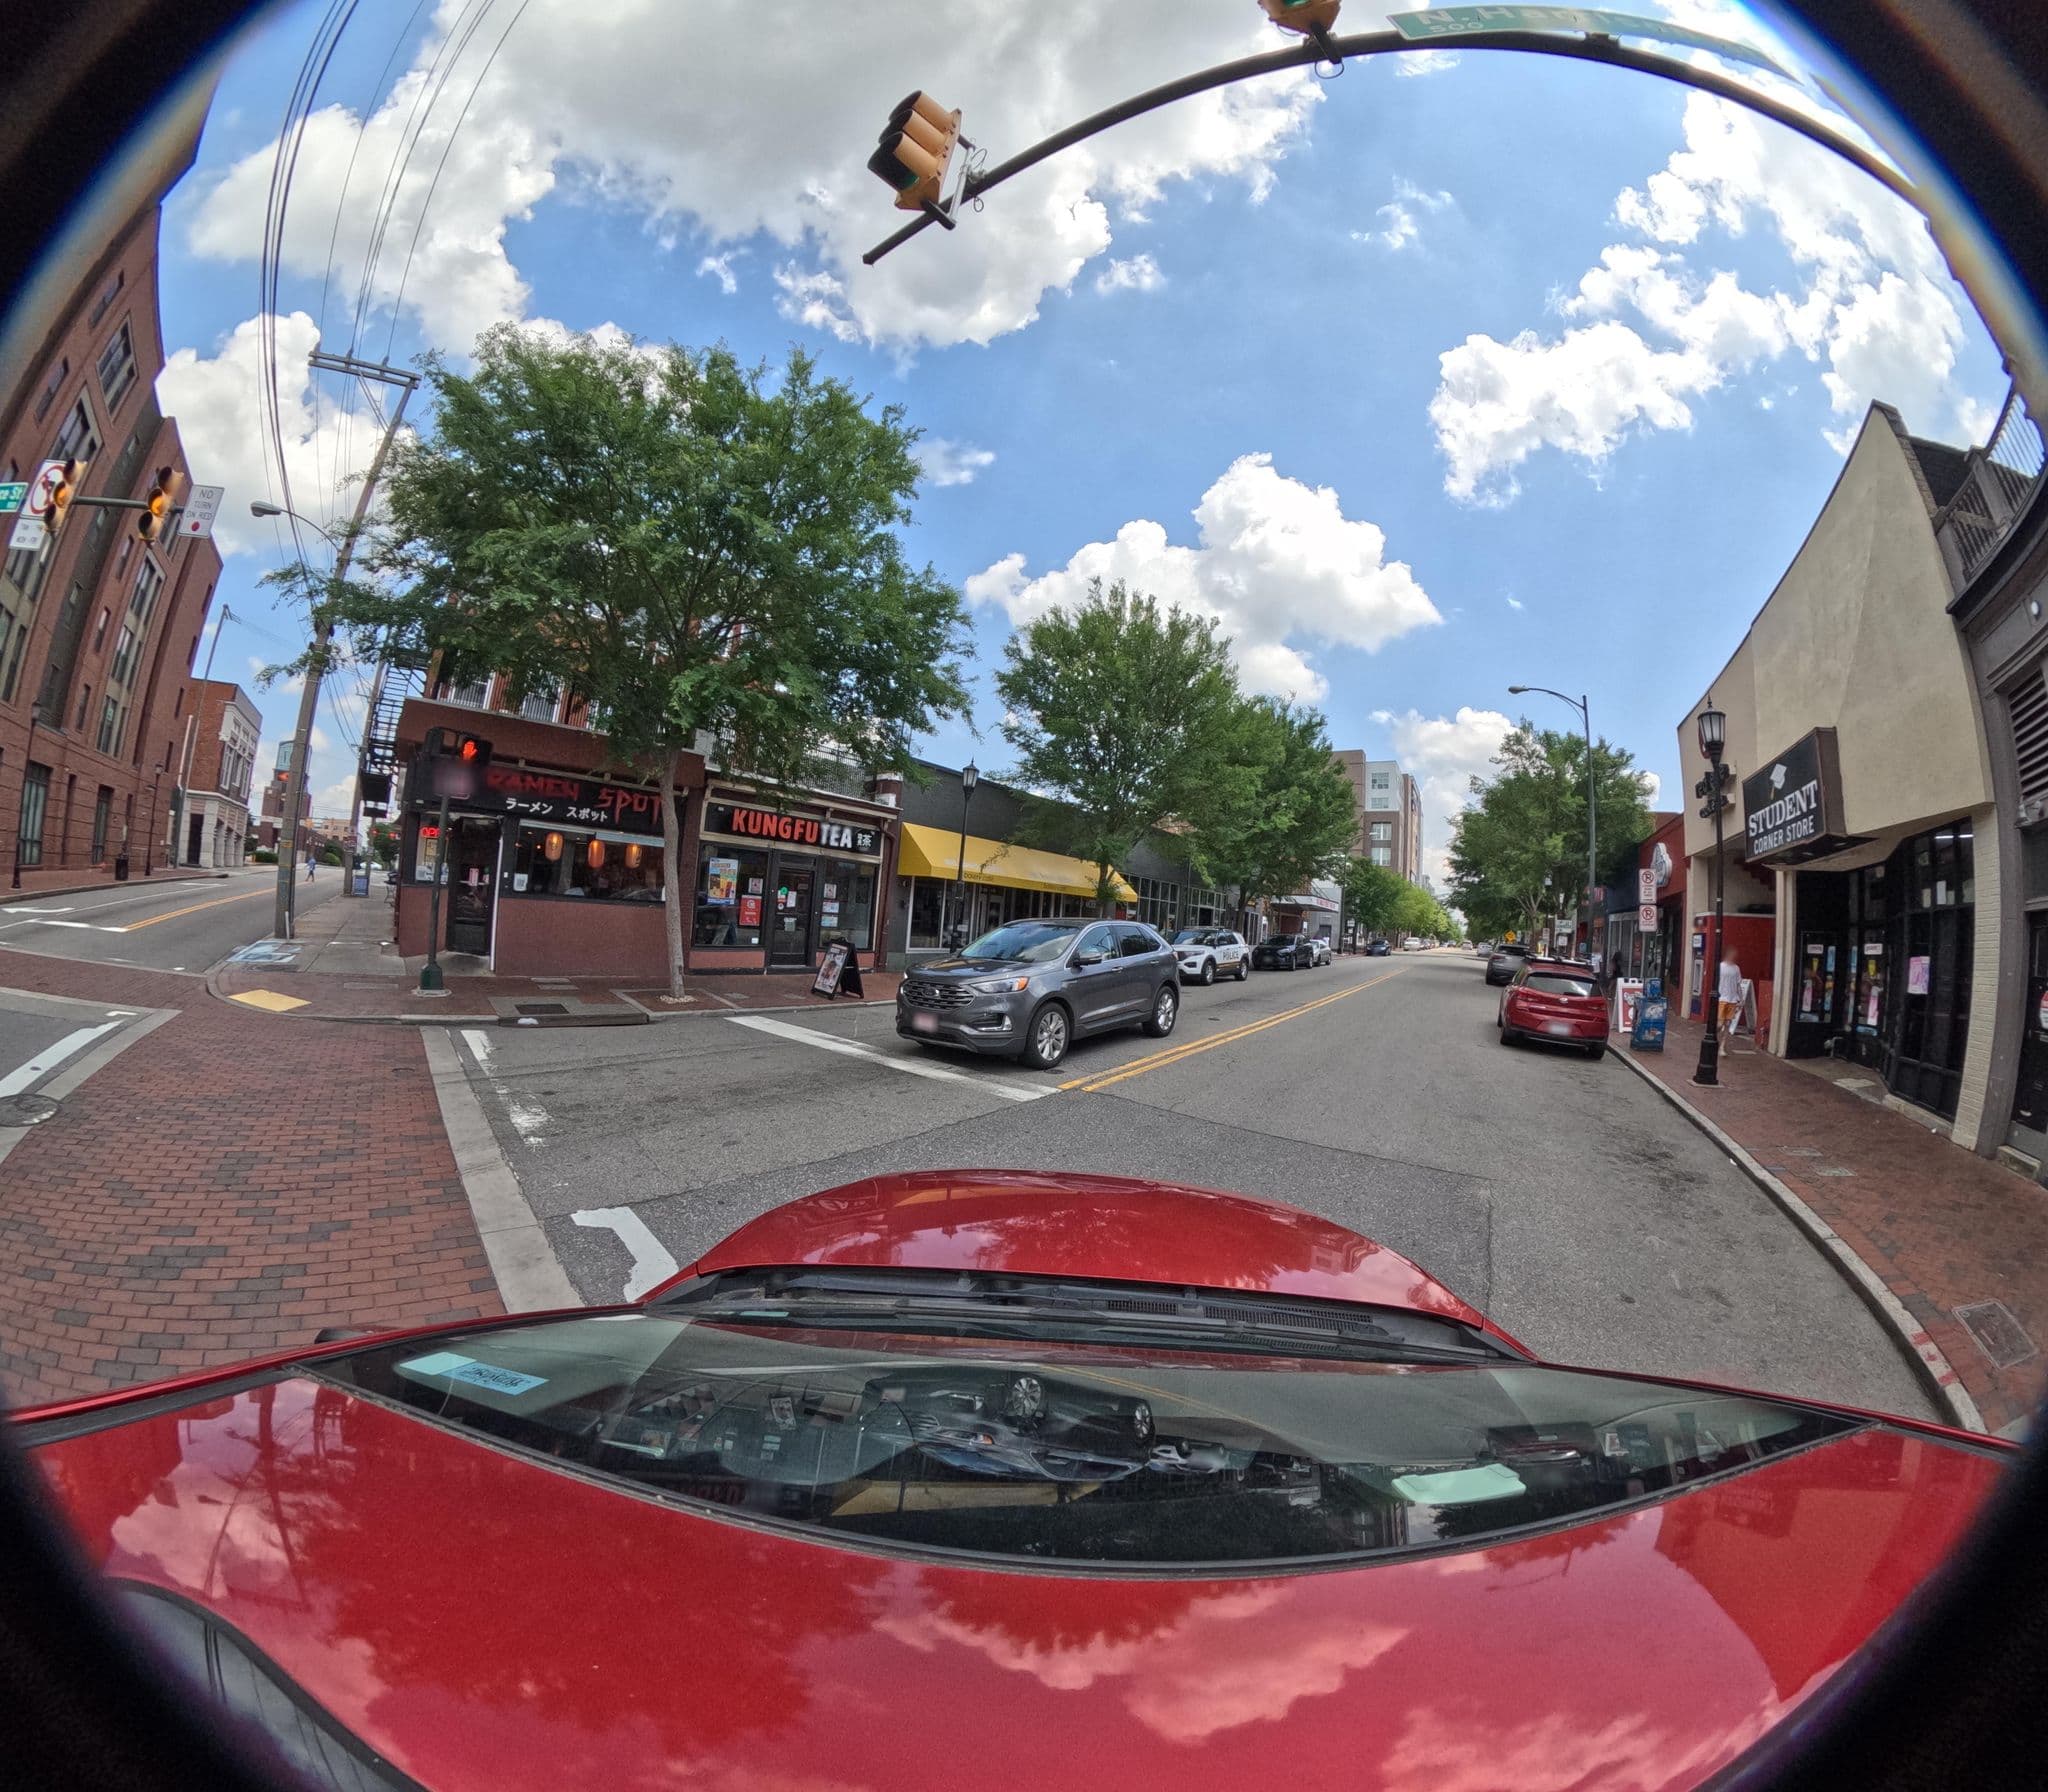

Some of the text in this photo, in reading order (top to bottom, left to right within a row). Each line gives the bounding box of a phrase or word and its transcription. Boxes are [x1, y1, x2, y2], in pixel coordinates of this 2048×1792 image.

[193, 501, 212, 509] TURN
[200, 489, 214, 499] NO
[186, 510, 213, 520] ON RED
[506, 797, 608, 822] ラーメン スポット
[594, 787, 663, 825] SPOT
[1748, 779, 1819, 838] STUDENT
[732, 808, 819, 844] KUNGFU
[820, 822, 852, 848] TEA
[1753, 815, 1815, 855] CORNER STORE
